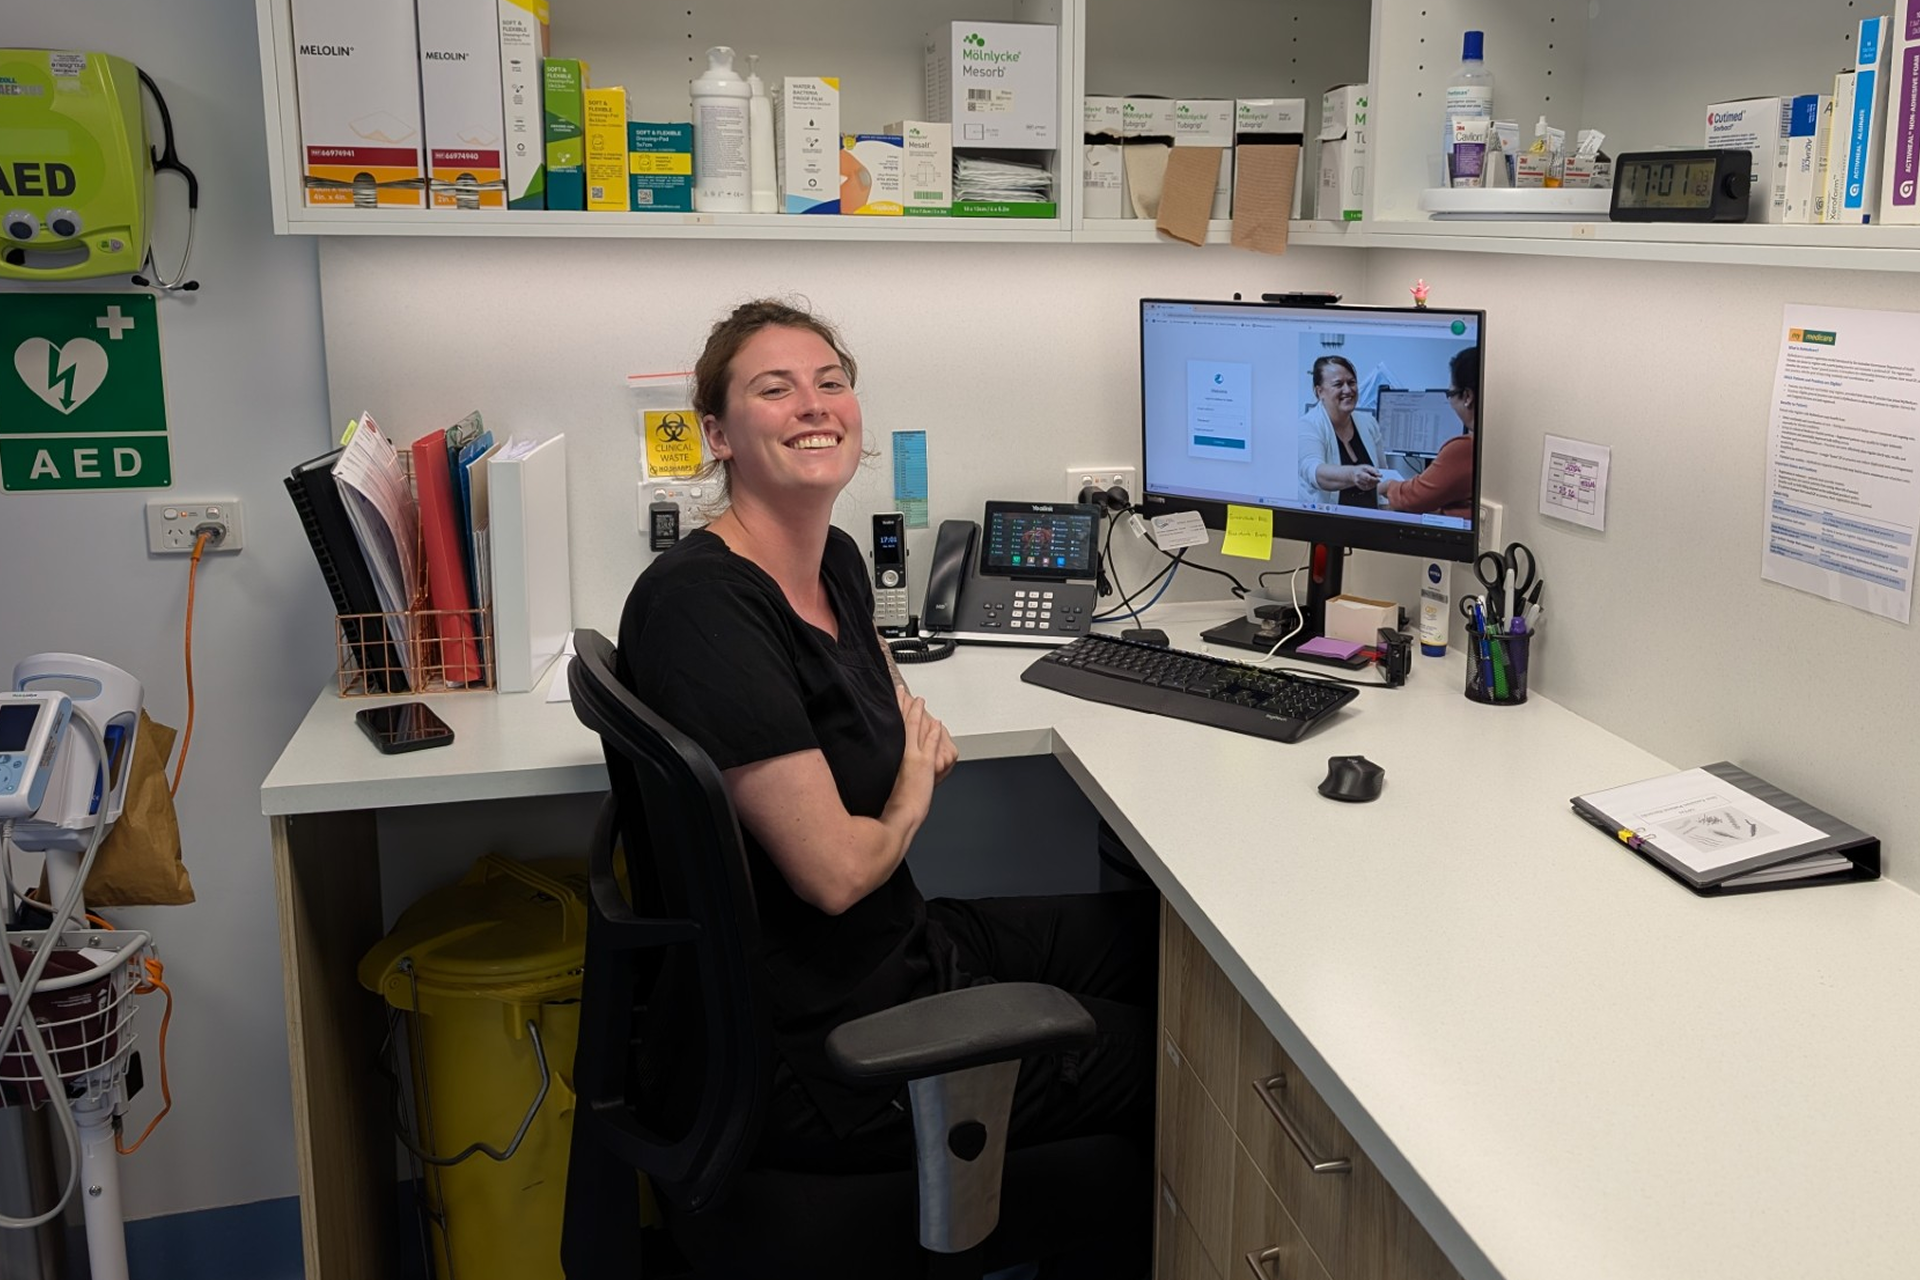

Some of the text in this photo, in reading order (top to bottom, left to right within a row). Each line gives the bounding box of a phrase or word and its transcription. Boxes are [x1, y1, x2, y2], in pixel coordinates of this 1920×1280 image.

[1908, 77, 1919, 130] NON-ADHESIVE
[1714, 113, 1743, 124] Cutimed
[1455, 131, 1483, 142] Cavilon
[1629, 163, 1690, 197] 17:01
[1805, 333, 1834, 343] medicare
[655, 443, 694, 453] CLINICAL
[659, 453, 690, 462] WASTE
